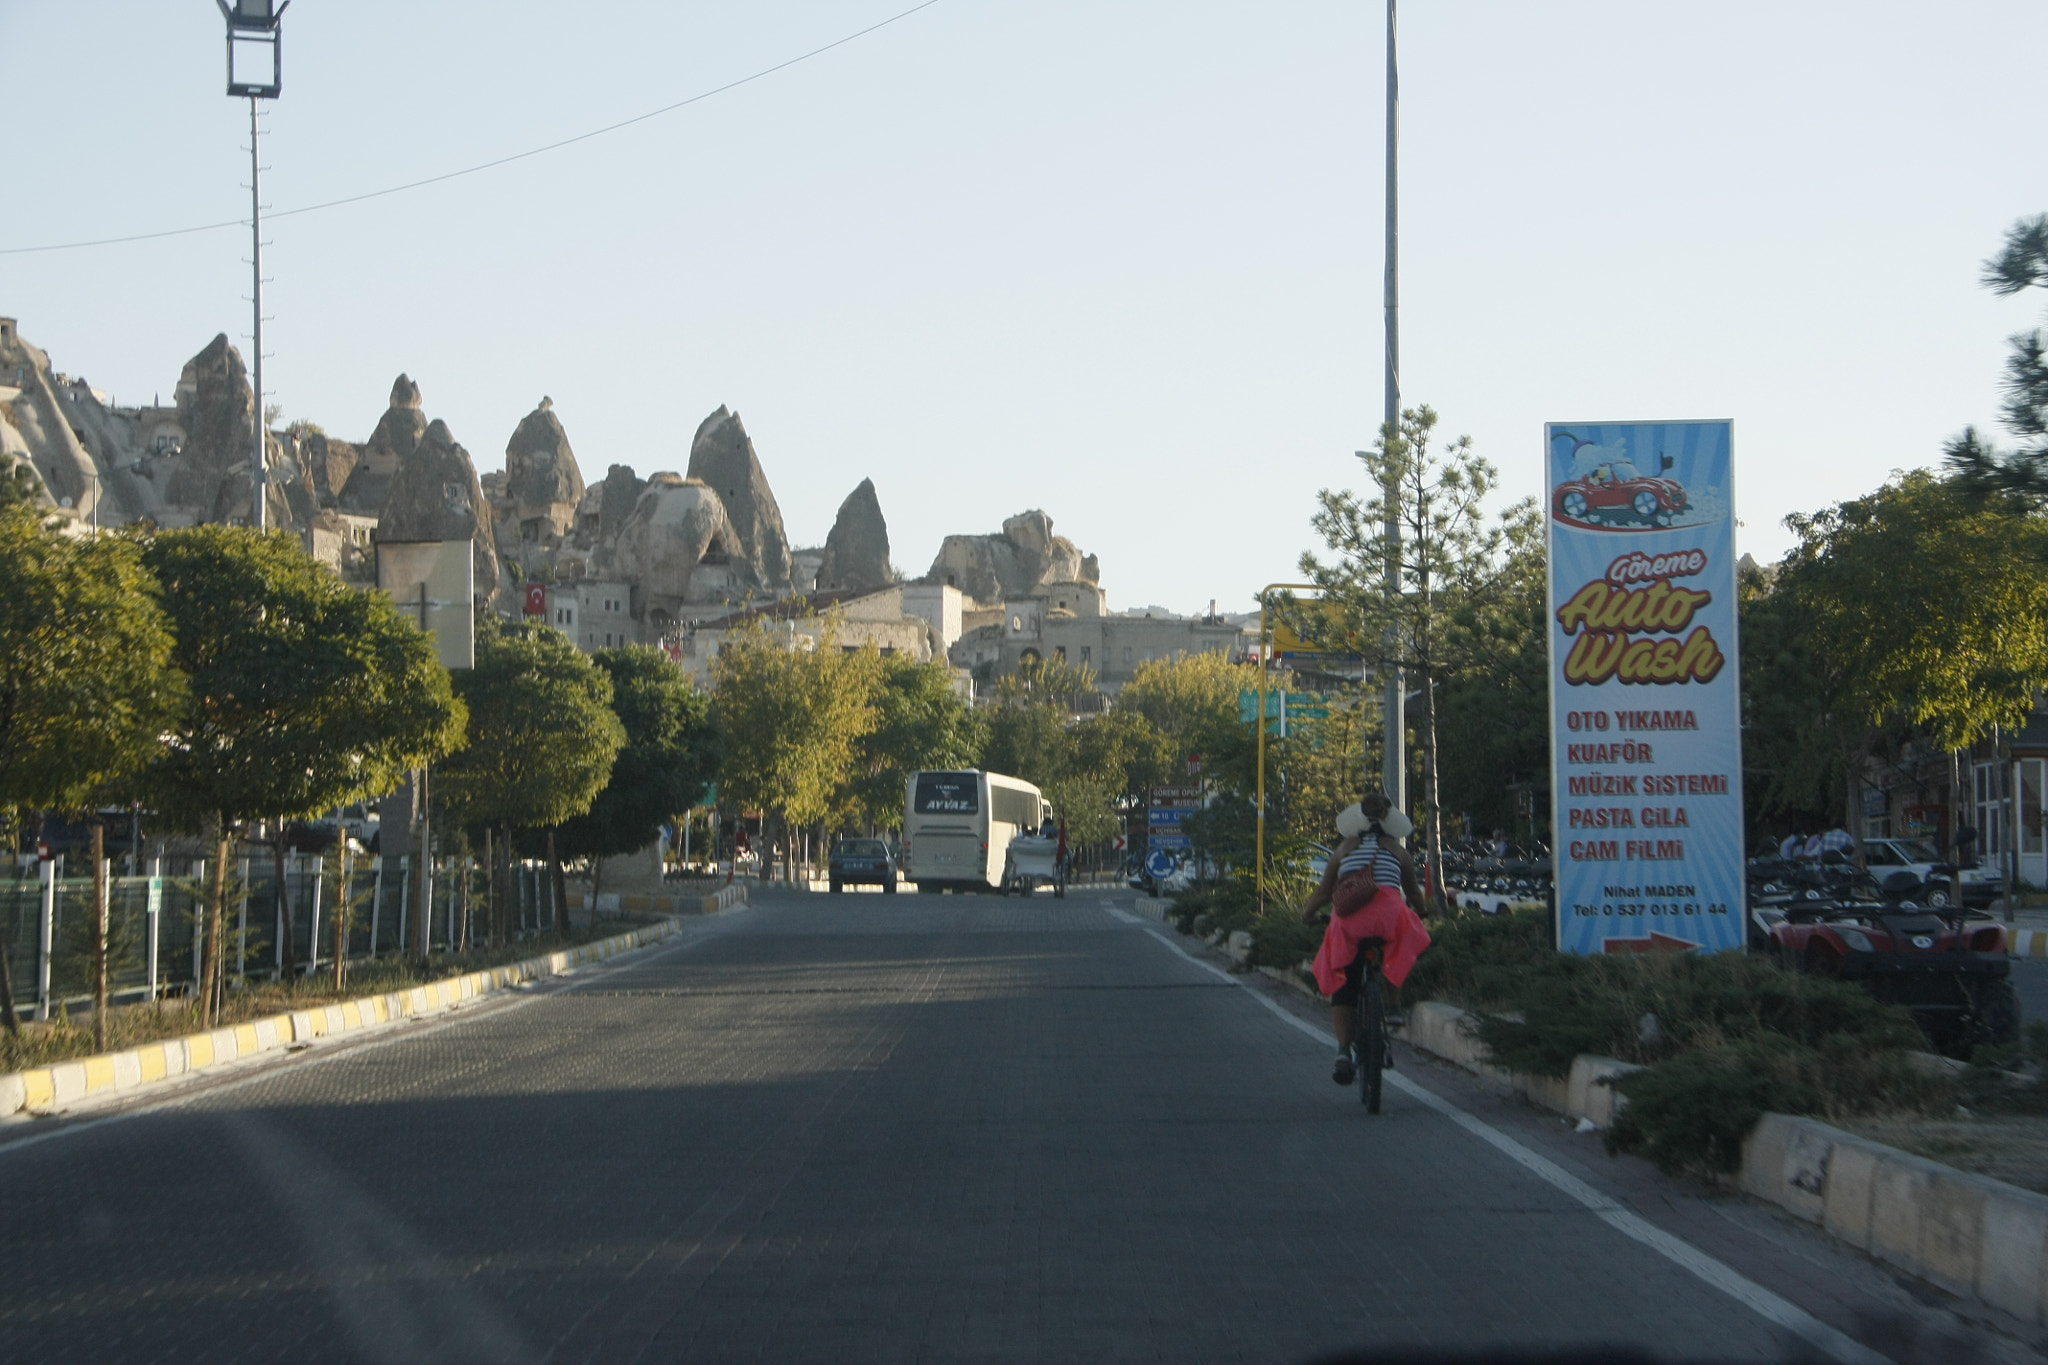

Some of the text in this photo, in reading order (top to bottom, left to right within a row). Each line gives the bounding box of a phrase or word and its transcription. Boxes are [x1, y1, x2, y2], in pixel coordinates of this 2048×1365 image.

[1609, 551, 1704, 583] Göreme
[1558, 579, 1709, 632] Auto
[1565, 627, 1722, 682] Wash
[1567, 710, 1698, 730] OTO YIKAMA
[1568, 739, 1653, 763] KUAFÖR
[926, 799, 969, 810] AYVAZ
[1569, 808, 1635, 828] PASTA
[1570, 840, 1618, 861] CAM
[1604, 885, 1696, 898] Nihat MADEN
[1573, 903, 1727, 917] Tel: 0 537 013 61 44
